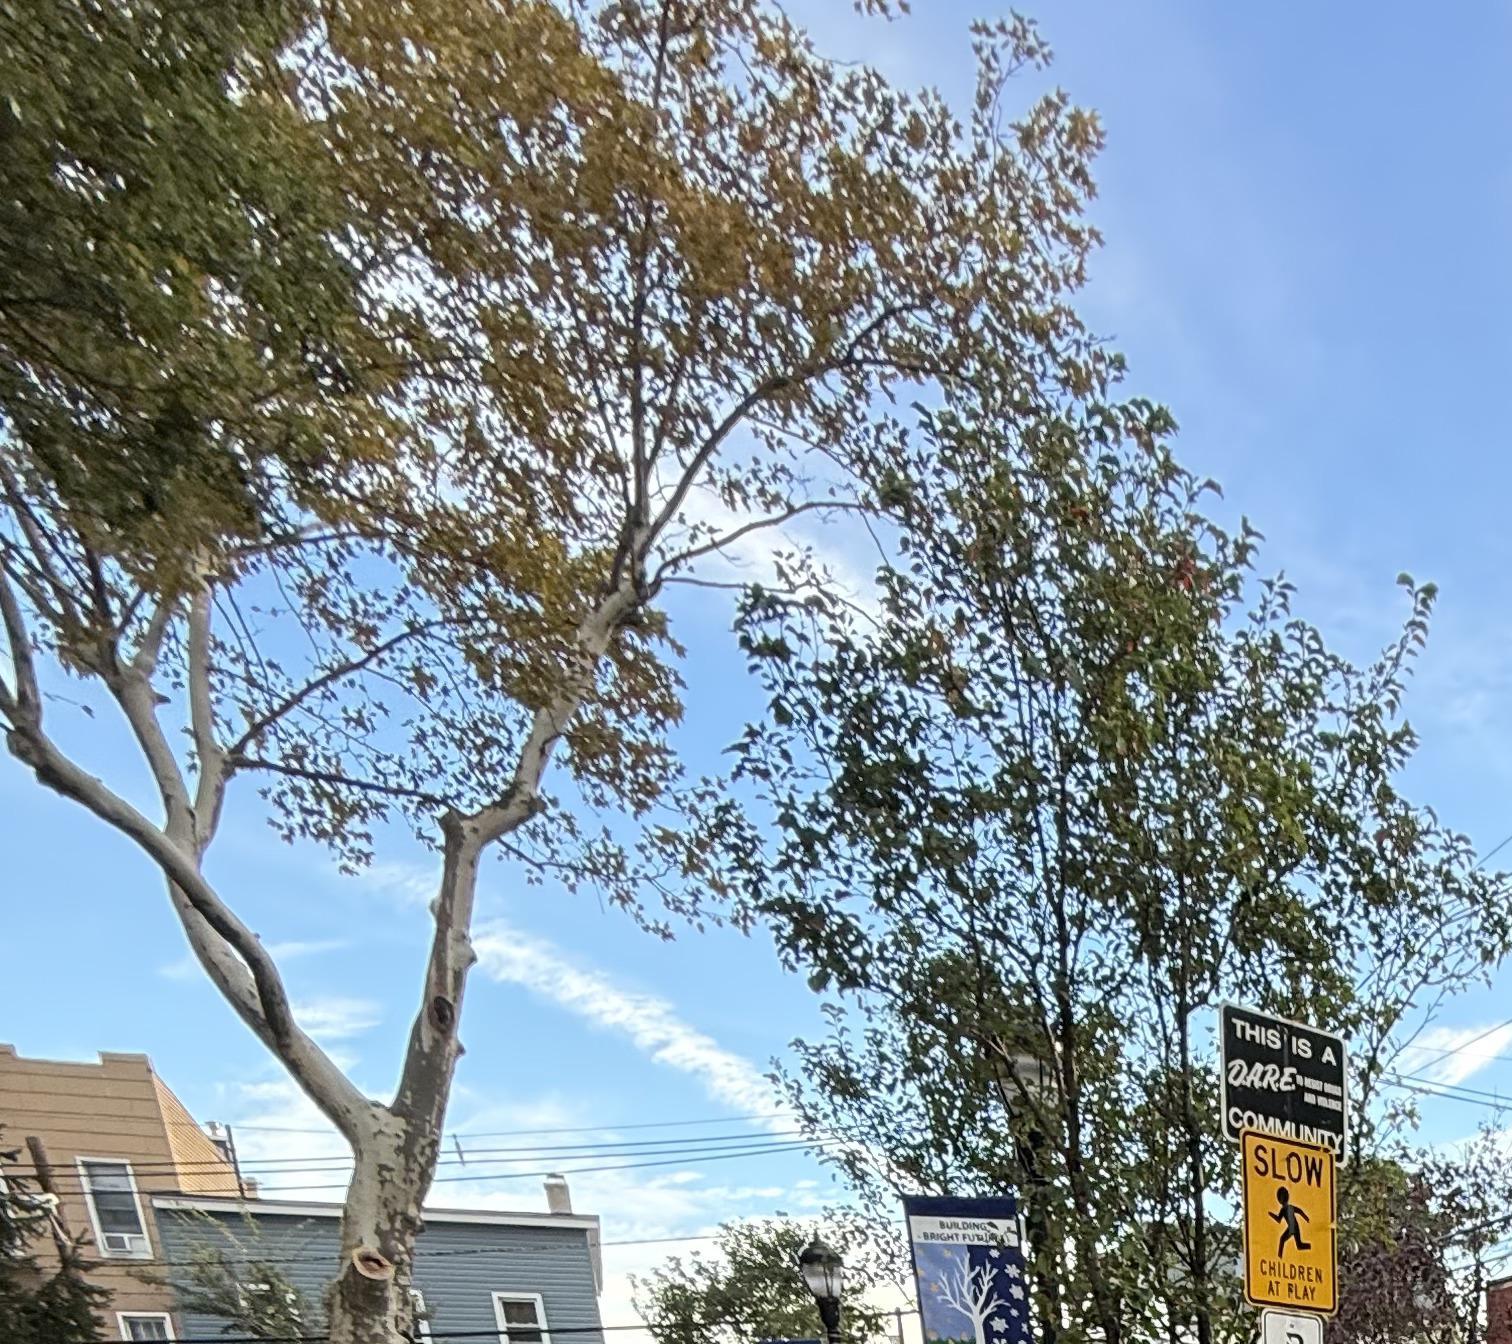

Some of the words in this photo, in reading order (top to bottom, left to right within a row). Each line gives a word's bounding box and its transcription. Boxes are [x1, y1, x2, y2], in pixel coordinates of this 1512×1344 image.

[1231, 1017, 1282, 1050] THIS
[1291, 1035, 1313, 1059] IS
[1320, 1045, 1337, 1067] A
[1228, 1106, 1344, 1155] COMMUNITY
[1253, 1144, 1323, 1188] SLOW
[922, 1231, 961, 1242] BRIGHT
[939, 1220, 988, 1232] BUILDING
[1259, 1258, 1323, 1284] CHILDREN
[1267, 1279, 1281, 1297] AT
[1287, 1282, 1316, 1301] PLAY
